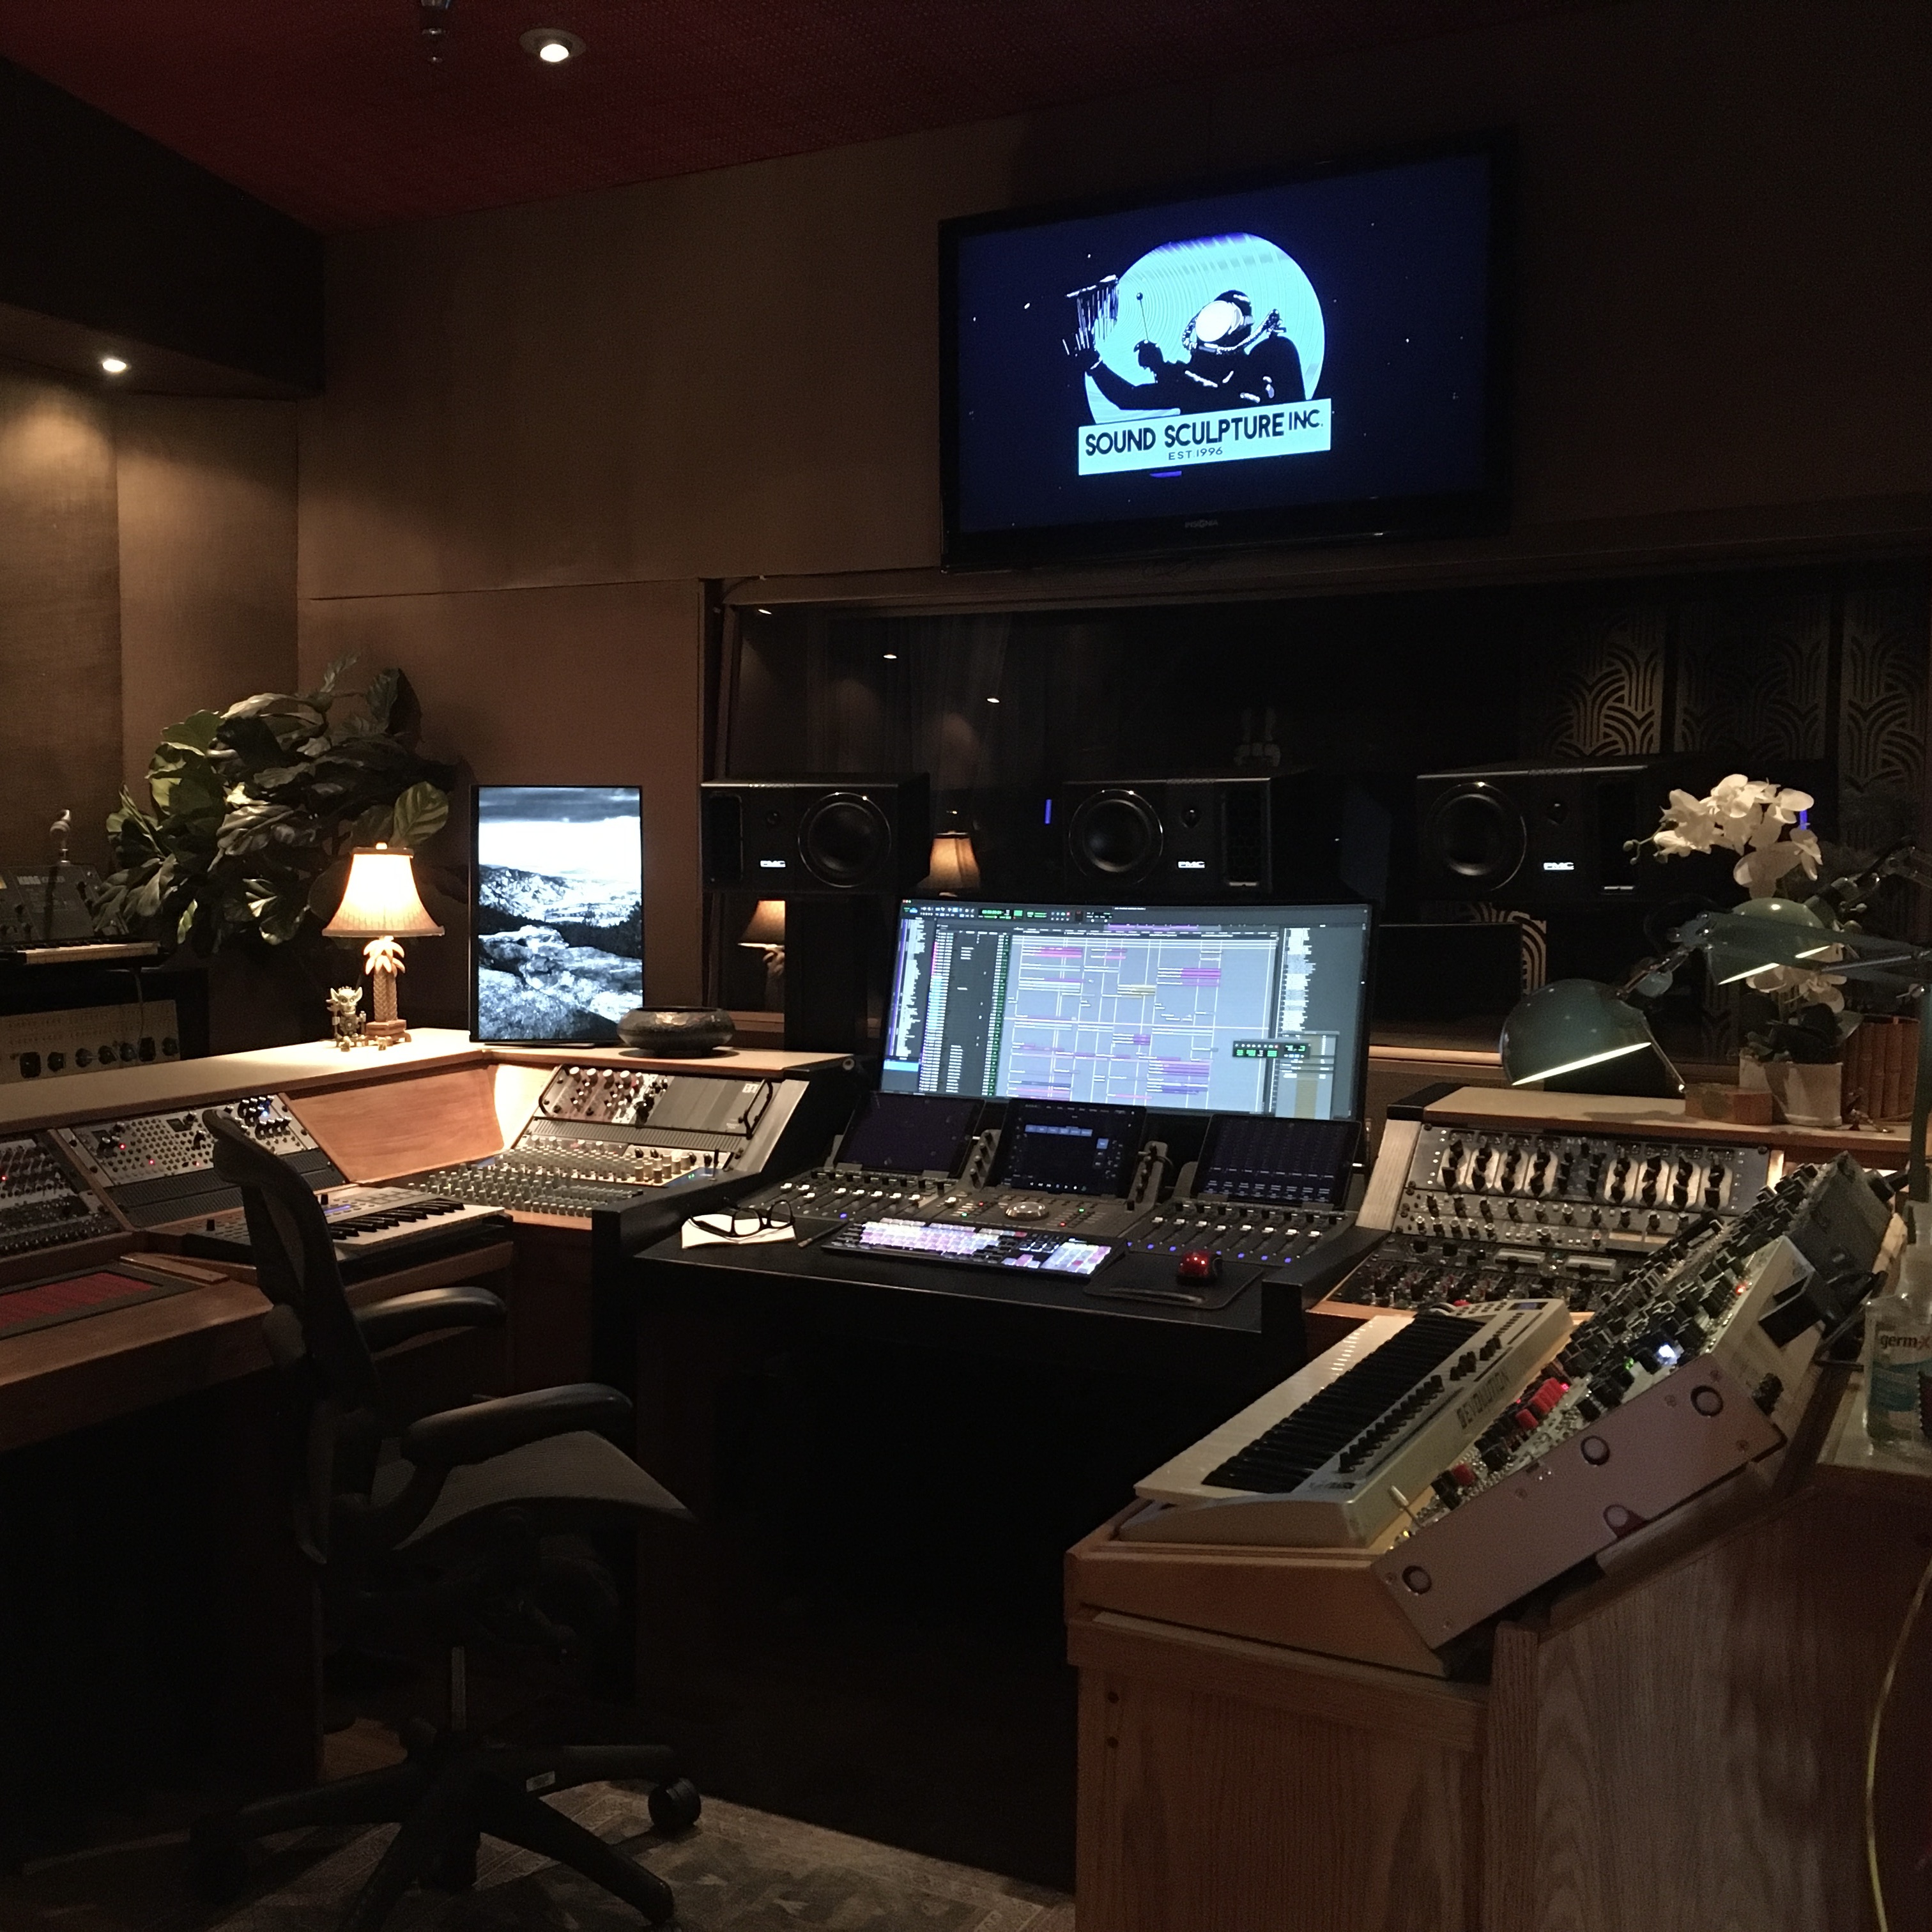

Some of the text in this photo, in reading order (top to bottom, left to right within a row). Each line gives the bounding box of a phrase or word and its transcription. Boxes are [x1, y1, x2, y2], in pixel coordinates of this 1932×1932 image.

[1085, 409, 1323, 456] SOUND SCULPTURE INC.
